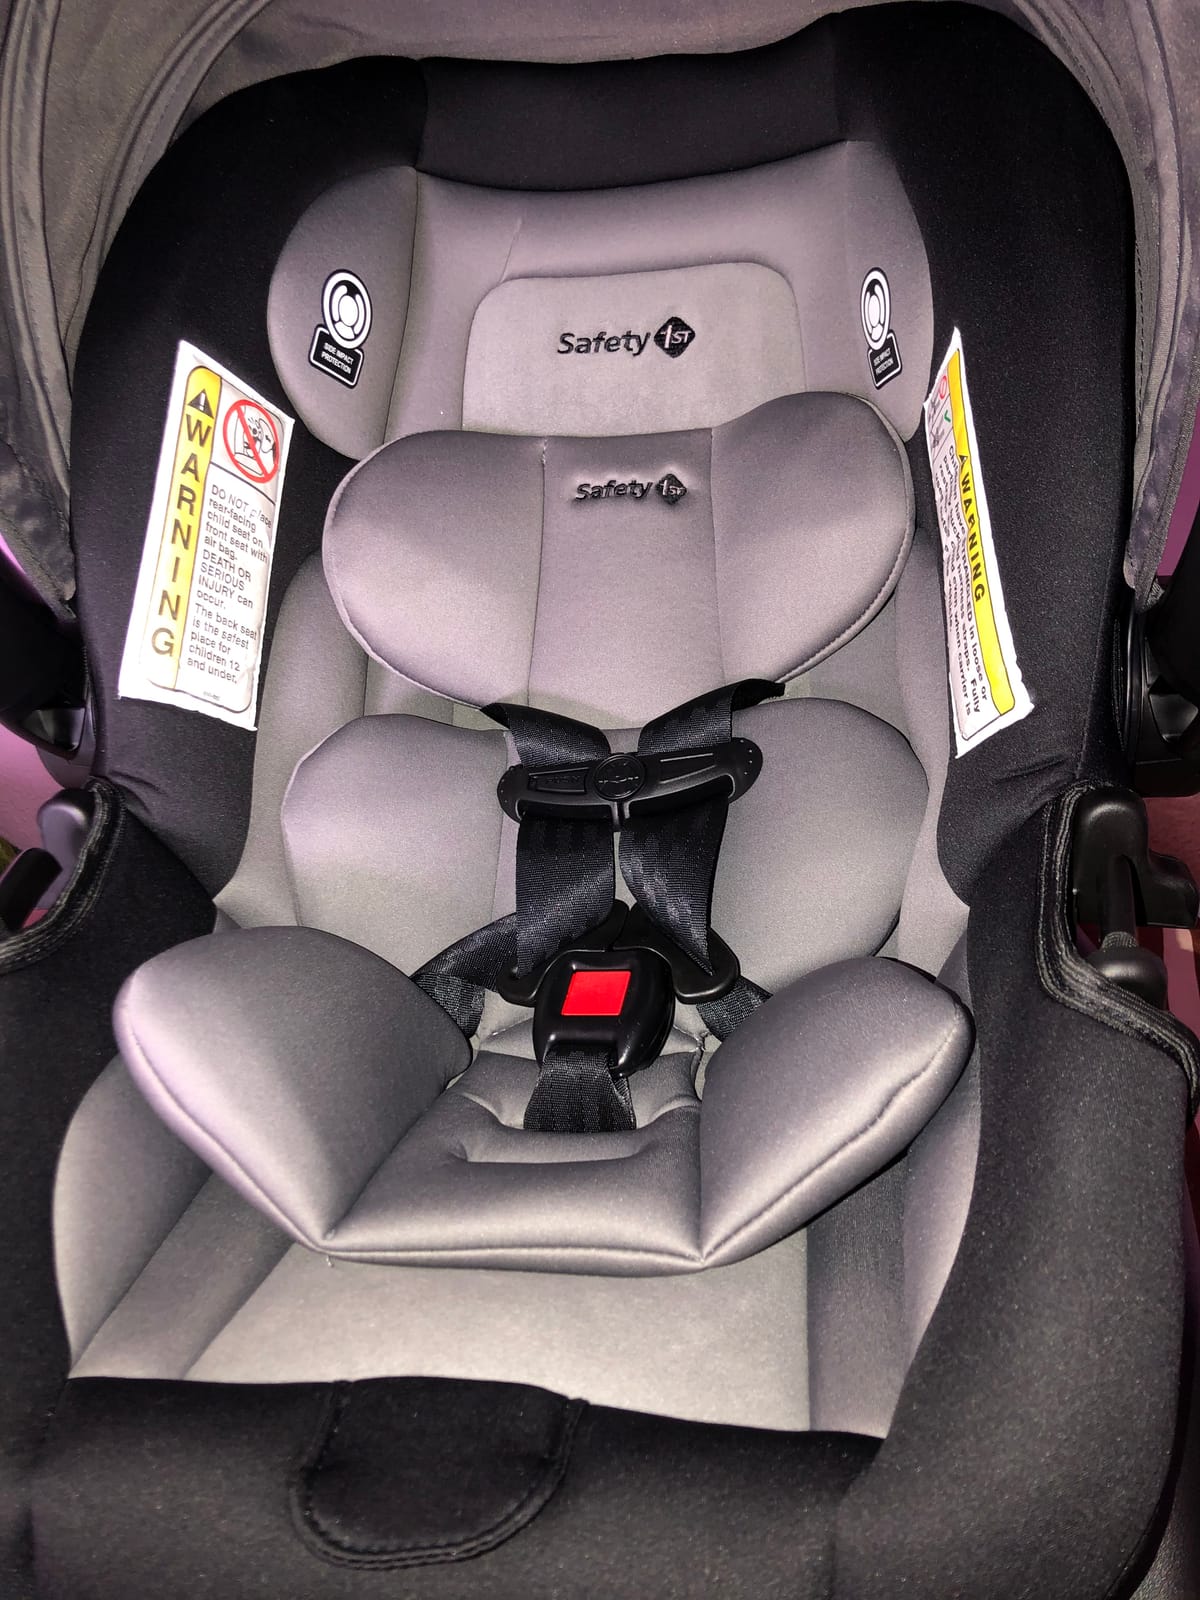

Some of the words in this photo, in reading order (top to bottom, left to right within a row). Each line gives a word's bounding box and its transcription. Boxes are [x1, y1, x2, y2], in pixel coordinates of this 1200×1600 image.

[556, 330, 651, 357] Safety
[212, 484, 226, 500] DO
[228, 494, 250, 512] NOT
[574, 479, 654, 500] Safety
[208, 511, 230, 529] child
[232, 524, 250, 541] seat
[252, 536, 264, 549] on
[209, 498, 256, 534] rear-facing
[151, 413, 212, 657] WARNING
[204, 535, 217, 548] air
[206, 521, 228, 541] front
[230, 537, 248, 553] seat
[250, 548, 268, 564] with
[200, 562, 245, 591] SERIOUS
[202, 548, 236, 574] DEATH
[238, 567, 252, 582] OR
[196, 590, 226, 610] occur.
[198, 574, 235, 599] INJURY
[237, 594, 254, 609] can
[192, 616, 201, 629] is
[204, 621, 219, 636] the
[221, 631, 249, 650] safest
[195, 602, 213, 619] The
[216, 612, 238, 632] back
[240, 625, 257, 641] seat
[188, 644, 227, 667] children
[230, 660, 240, 672] 12
[190, 631, 216, 649] place
[218, 641, 231, 655] for
[187, 657, 206, 672] and
[208, 666, 238, 684] under.
[972, 642, 983, 682] loose
[970, 678, 981, 713] Fully
